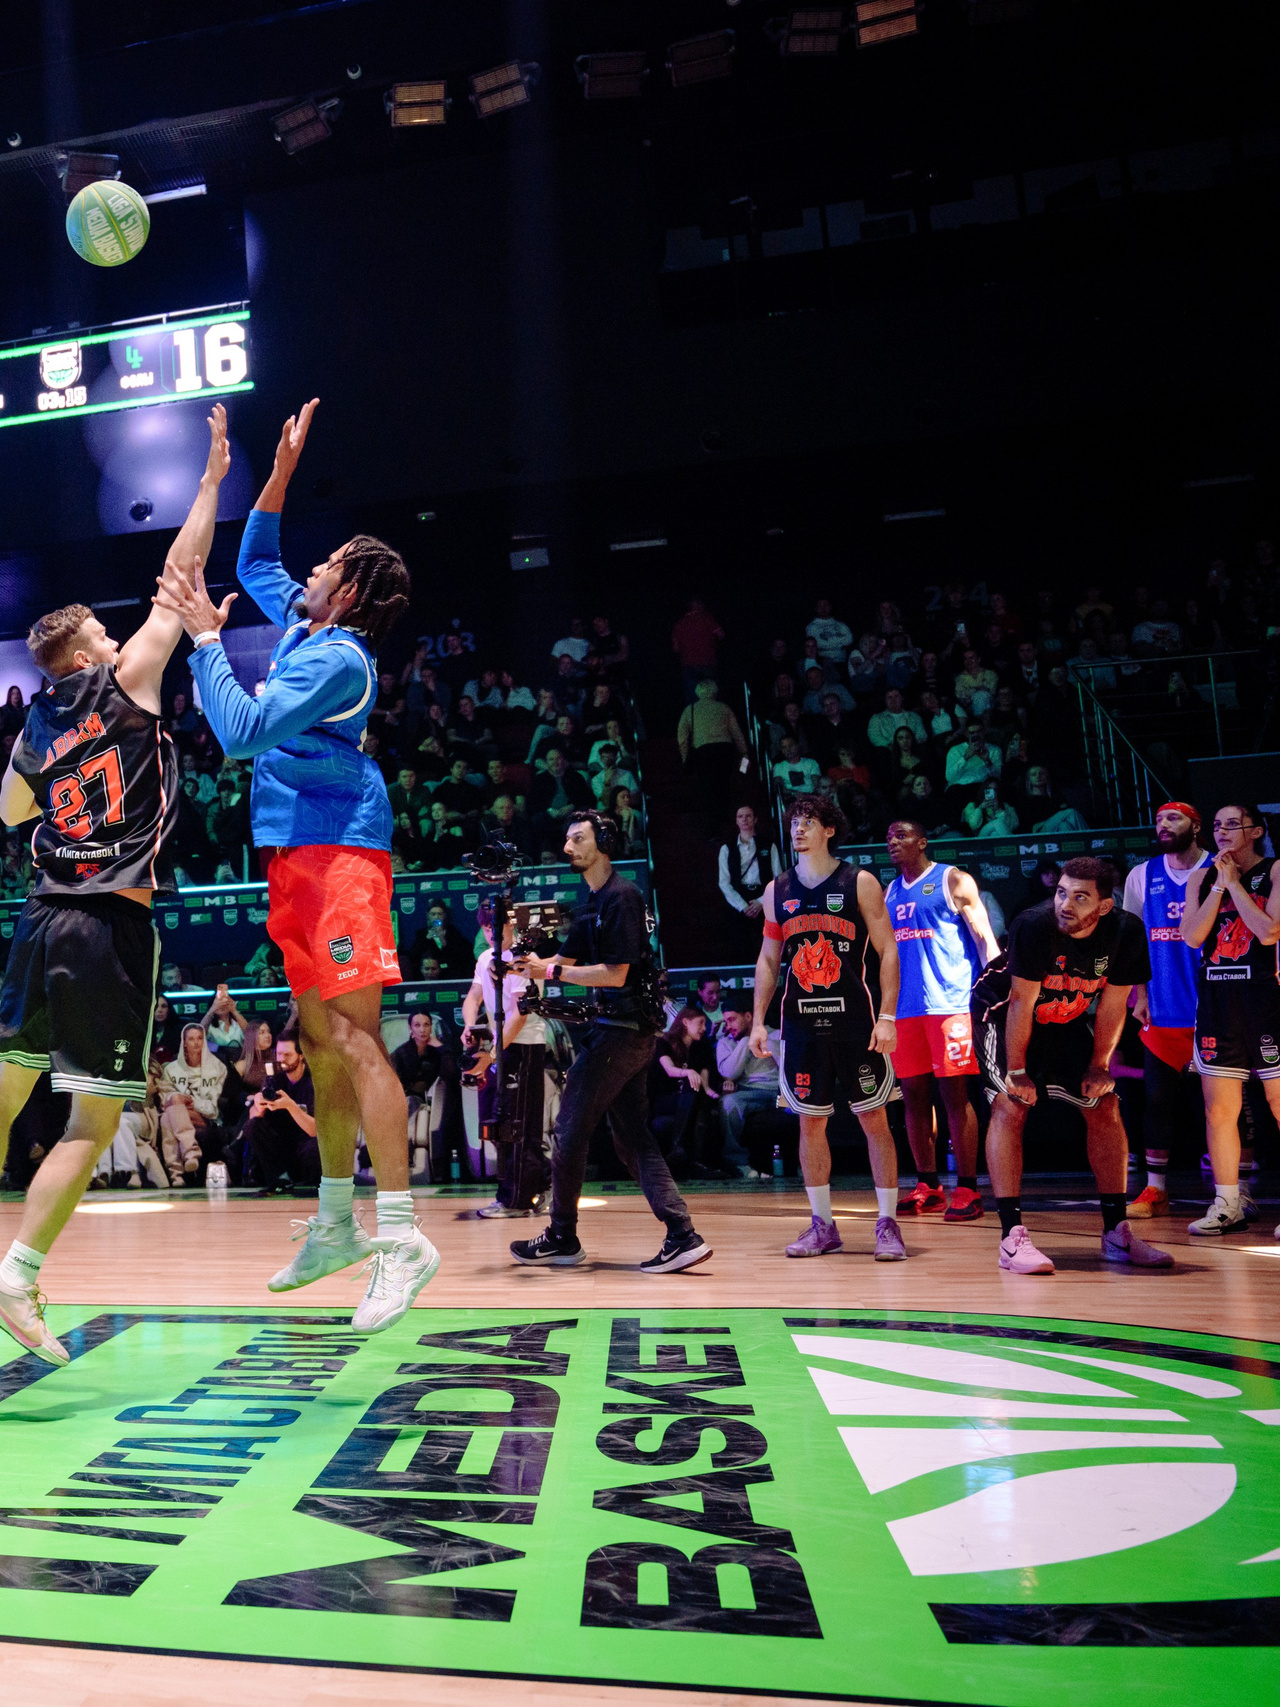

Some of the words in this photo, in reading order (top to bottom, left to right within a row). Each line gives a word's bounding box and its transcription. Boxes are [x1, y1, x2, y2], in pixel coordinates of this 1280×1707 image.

[107, 194, 133, 221] LIGA
[86, 207, 111, 240] MEDIA
[125, 345, 144, 370] 4
[173, 322, 248, 393] 16
[895, 901, 917, 921] 27
[838, 941, 850, 952] 23
[894, 929, 934, 942] ОССИЯ
[947, 1039, 973, 1061] 27
[13, 1255, 41, 1271] adidas
[114, 1325, 368, 1429] СТАВОК
[220, 1318, 579, 1624] MEDIA
[579, 1316, 825, 1641] BASKET
